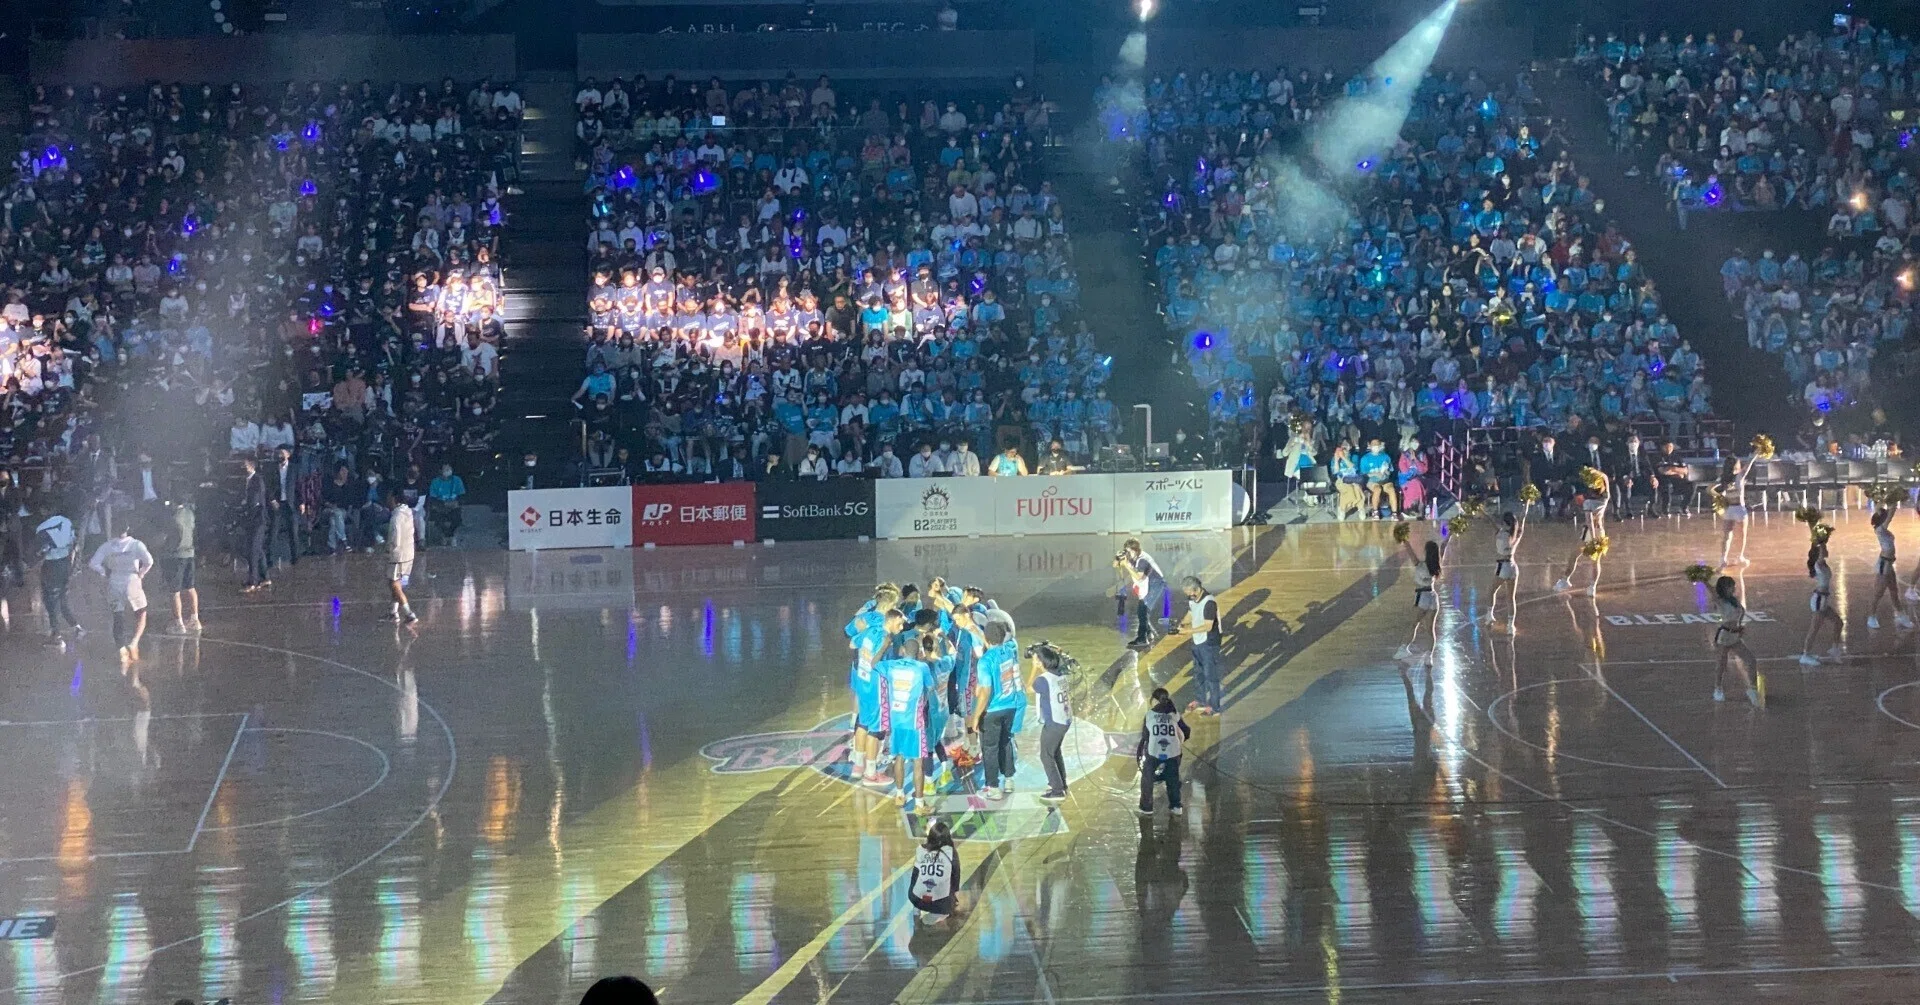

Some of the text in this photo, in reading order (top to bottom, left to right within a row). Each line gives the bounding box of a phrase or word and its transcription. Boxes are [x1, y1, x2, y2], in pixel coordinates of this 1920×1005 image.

[549, 507, 622, 527] 日本生命
[680, 504, 747, 523] 日本郵便
[783, 501, 869, 519] SoftBank 5G
[1016, 497, 1092, 523] FUJITSU
[1155, 511, 1192, 522] WINNER
[914, 519, 930, 531] B2
[1152, 724, 1176, 737] 038
